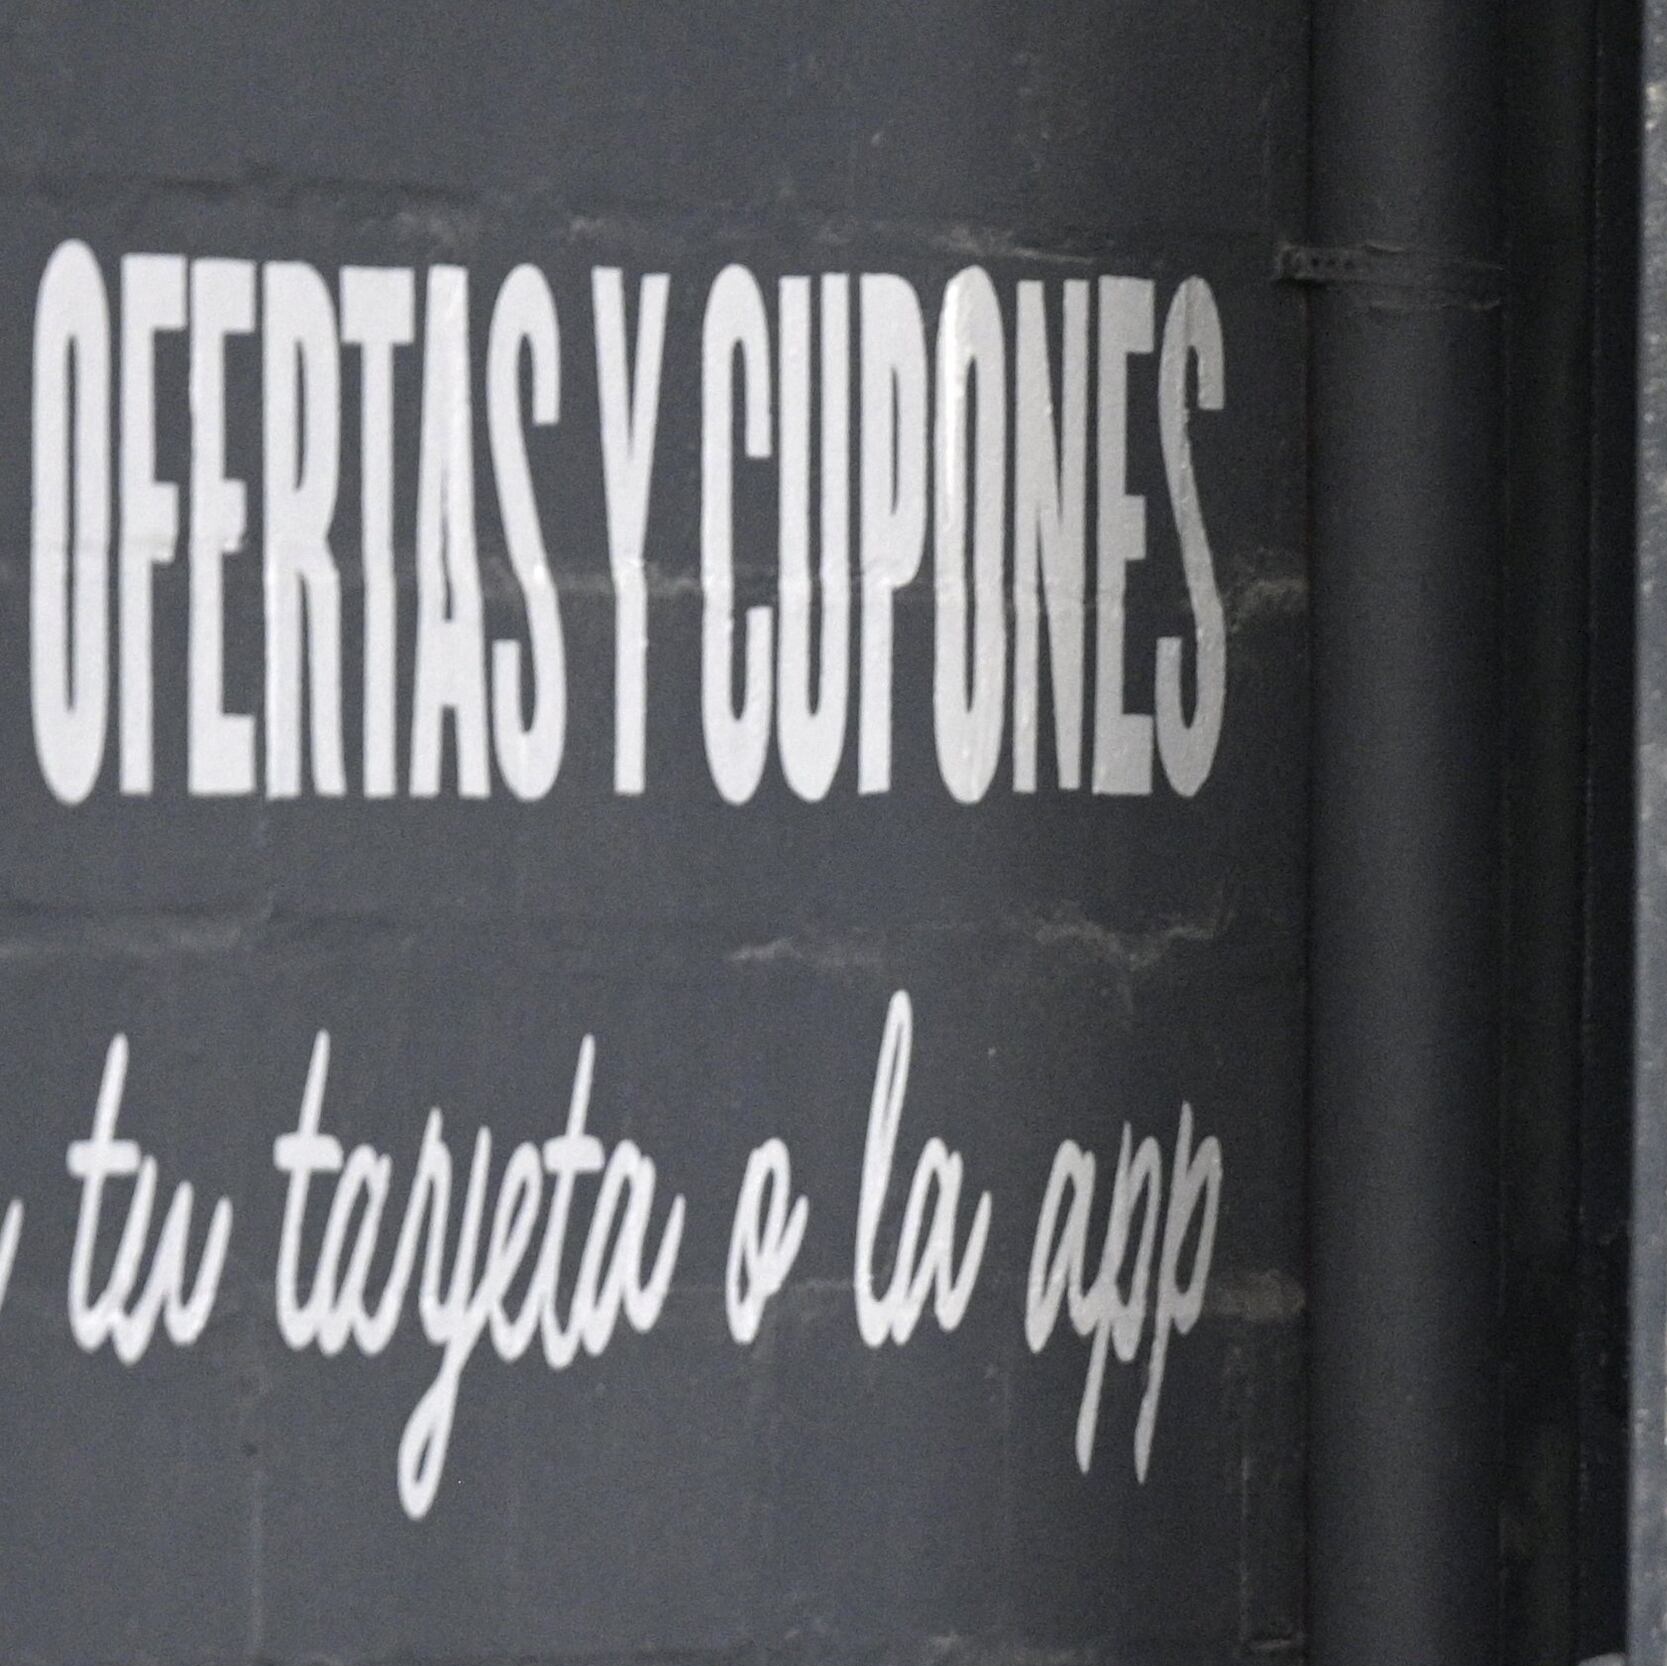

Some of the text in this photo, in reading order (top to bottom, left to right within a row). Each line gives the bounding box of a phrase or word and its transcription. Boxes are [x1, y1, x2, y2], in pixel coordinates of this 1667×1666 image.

[32, 238, 1227, 805] OFERTAS Y CUPONES
[67, 990, 1222, 1519] tu tarjeta o la app
